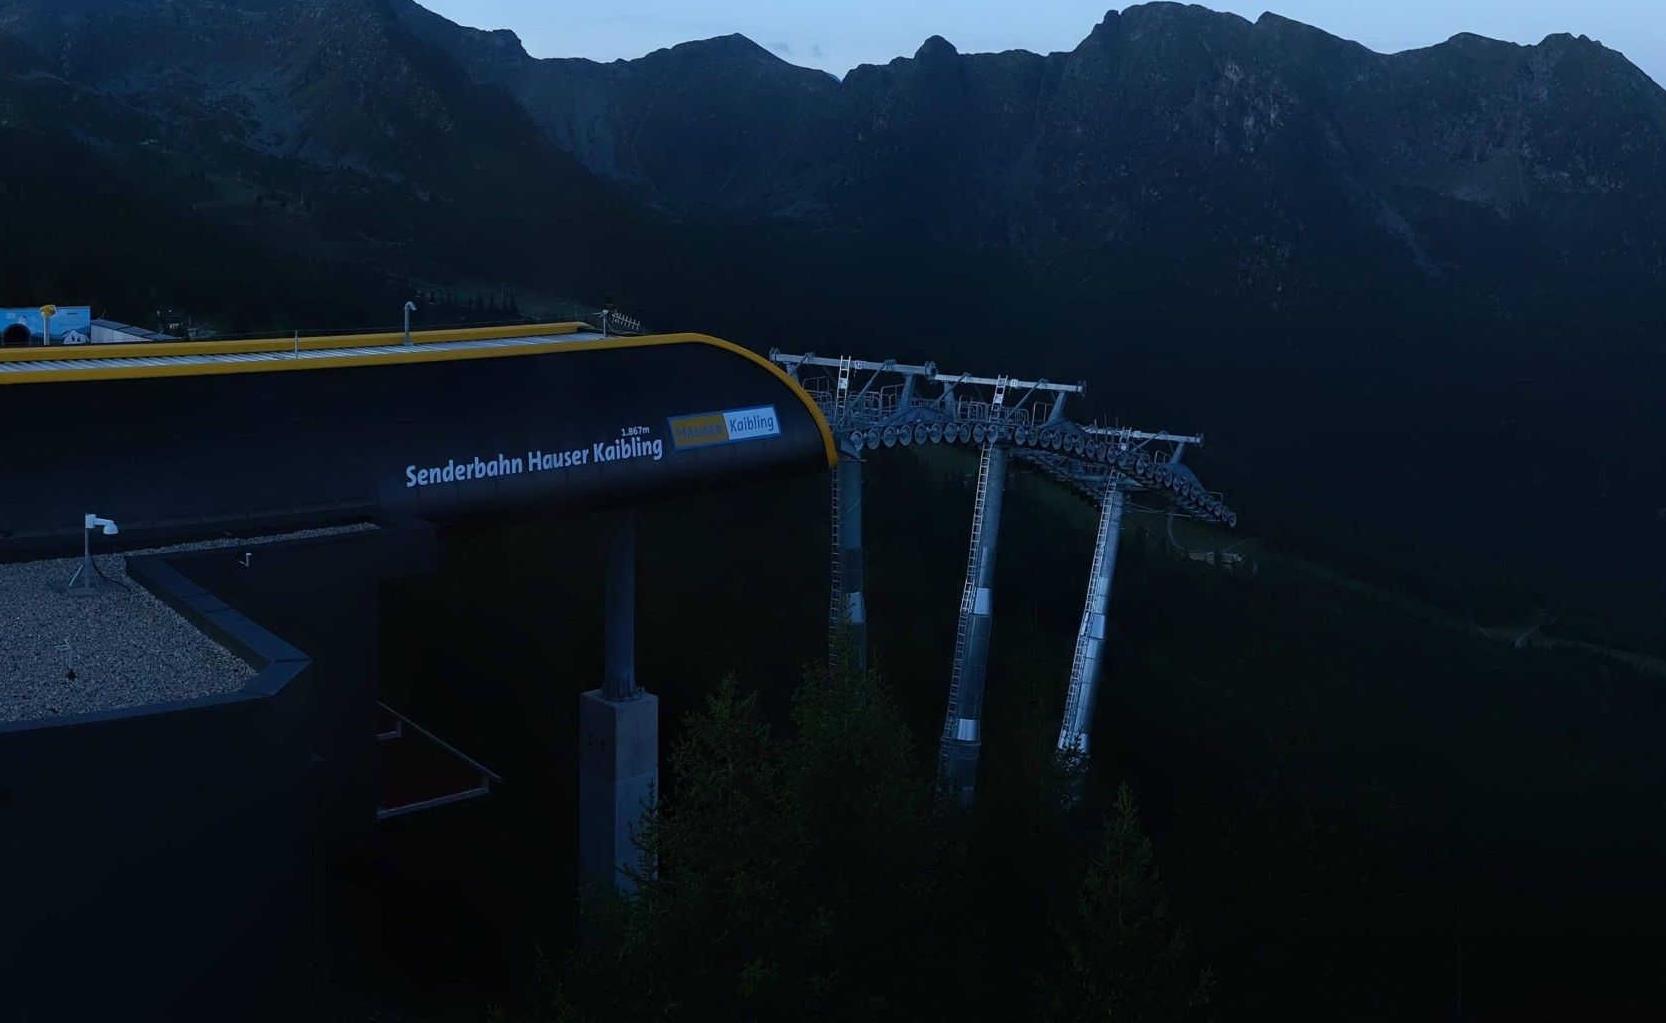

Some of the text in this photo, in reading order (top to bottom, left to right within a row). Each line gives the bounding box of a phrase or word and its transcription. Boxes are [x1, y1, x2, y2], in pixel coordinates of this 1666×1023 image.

[620, 425, 650, 438] 1.867m
[729, 415, 774, 432] Kaibling
[406, 437, 663, 488] Senderbahn Hauser Kaibling
